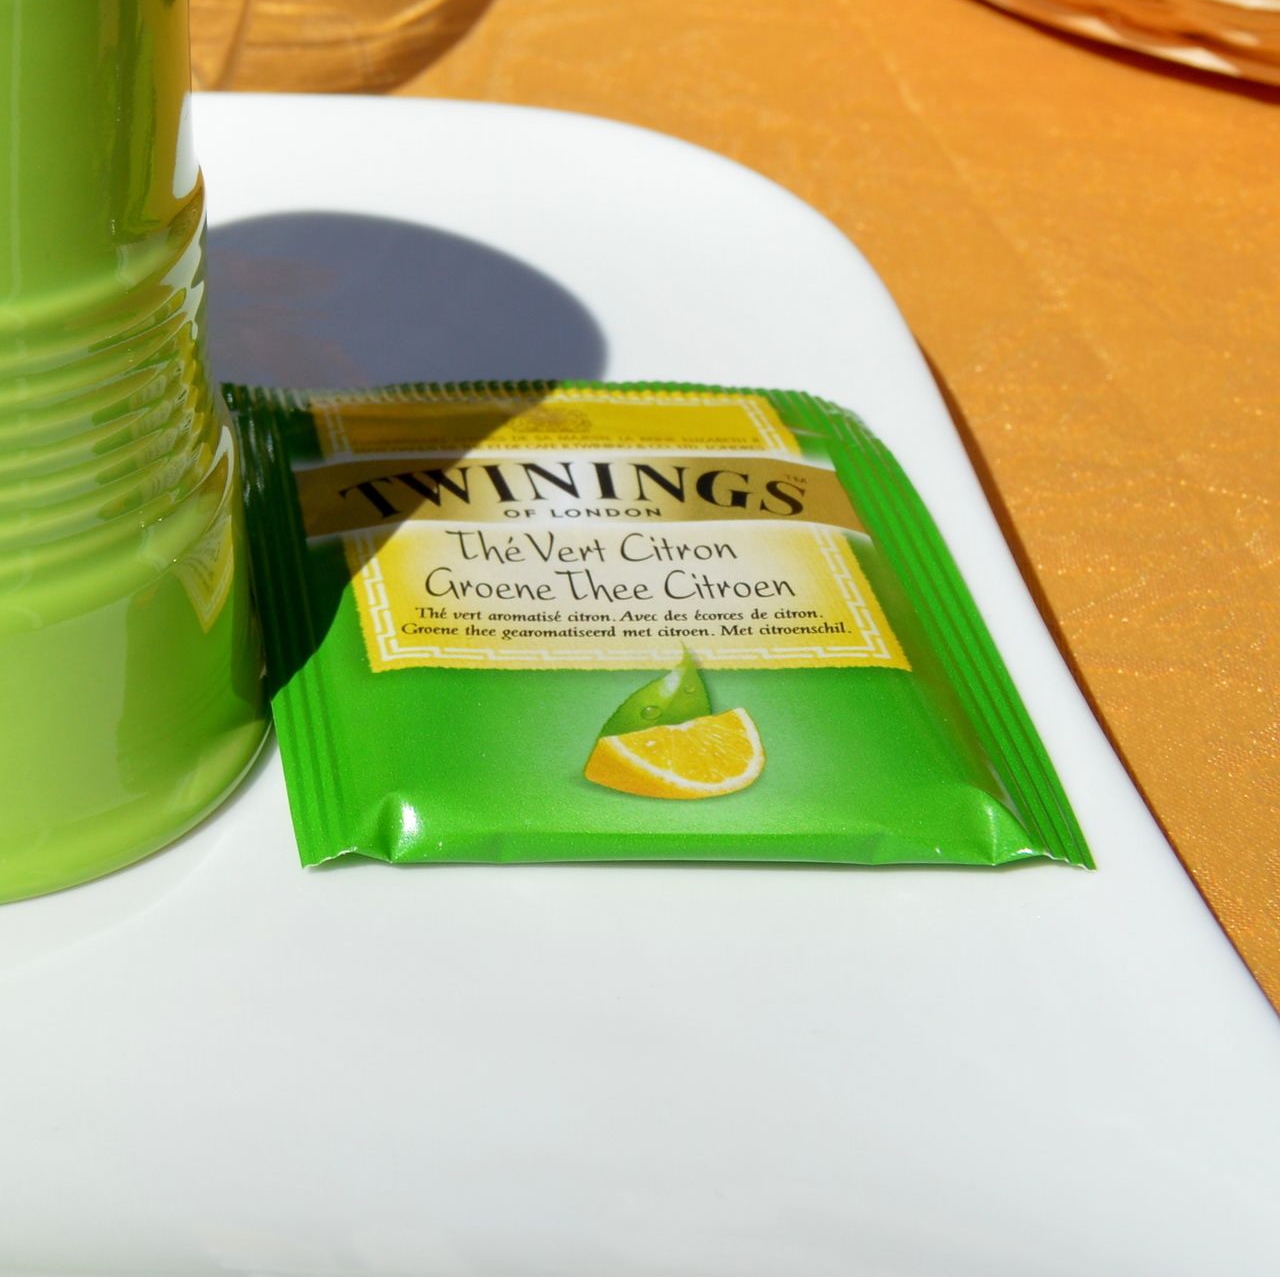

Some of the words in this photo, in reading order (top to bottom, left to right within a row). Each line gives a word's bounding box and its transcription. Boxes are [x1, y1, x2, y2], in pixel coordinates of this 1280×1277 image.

[339, 461, 807, 519] TWININGS
[504, 509, 536, 519] OF
[551, 507, 663, 520] LONDON
[446, 530, 524, 564] Thé
[524, 531, 607, 564] Vert
[620, 532, 738, 563] Citron
[425, 567, 556, 602] Groene
[555, 567, 653, 602] Thee
[664, 569, 796, 600] Citroen
[416, 606, 447, 621] Thé
[453, 610, 483, 622] vert
[488, 609, 562, 622] aromatisé
[567, 609, 616, 622] citron.
[620, 609, 658, 622] Avec
[664, 608, 689, 622] des
[694, 608, 743, 622] écorces
[750, 607, 768, 621] de
[774, 607, 823, 620] citron.
[401, 623, 458, 637] Groene
[465, 624, 497, 637] thee
[502, 624, 616, 641] gearomatiseerd
[623, 626, 651, 638] met
[657, 624, 715, 638] citroen.
[721, 624, 753, 636] Met
[760, 622, 851, 635] citroenschil.
